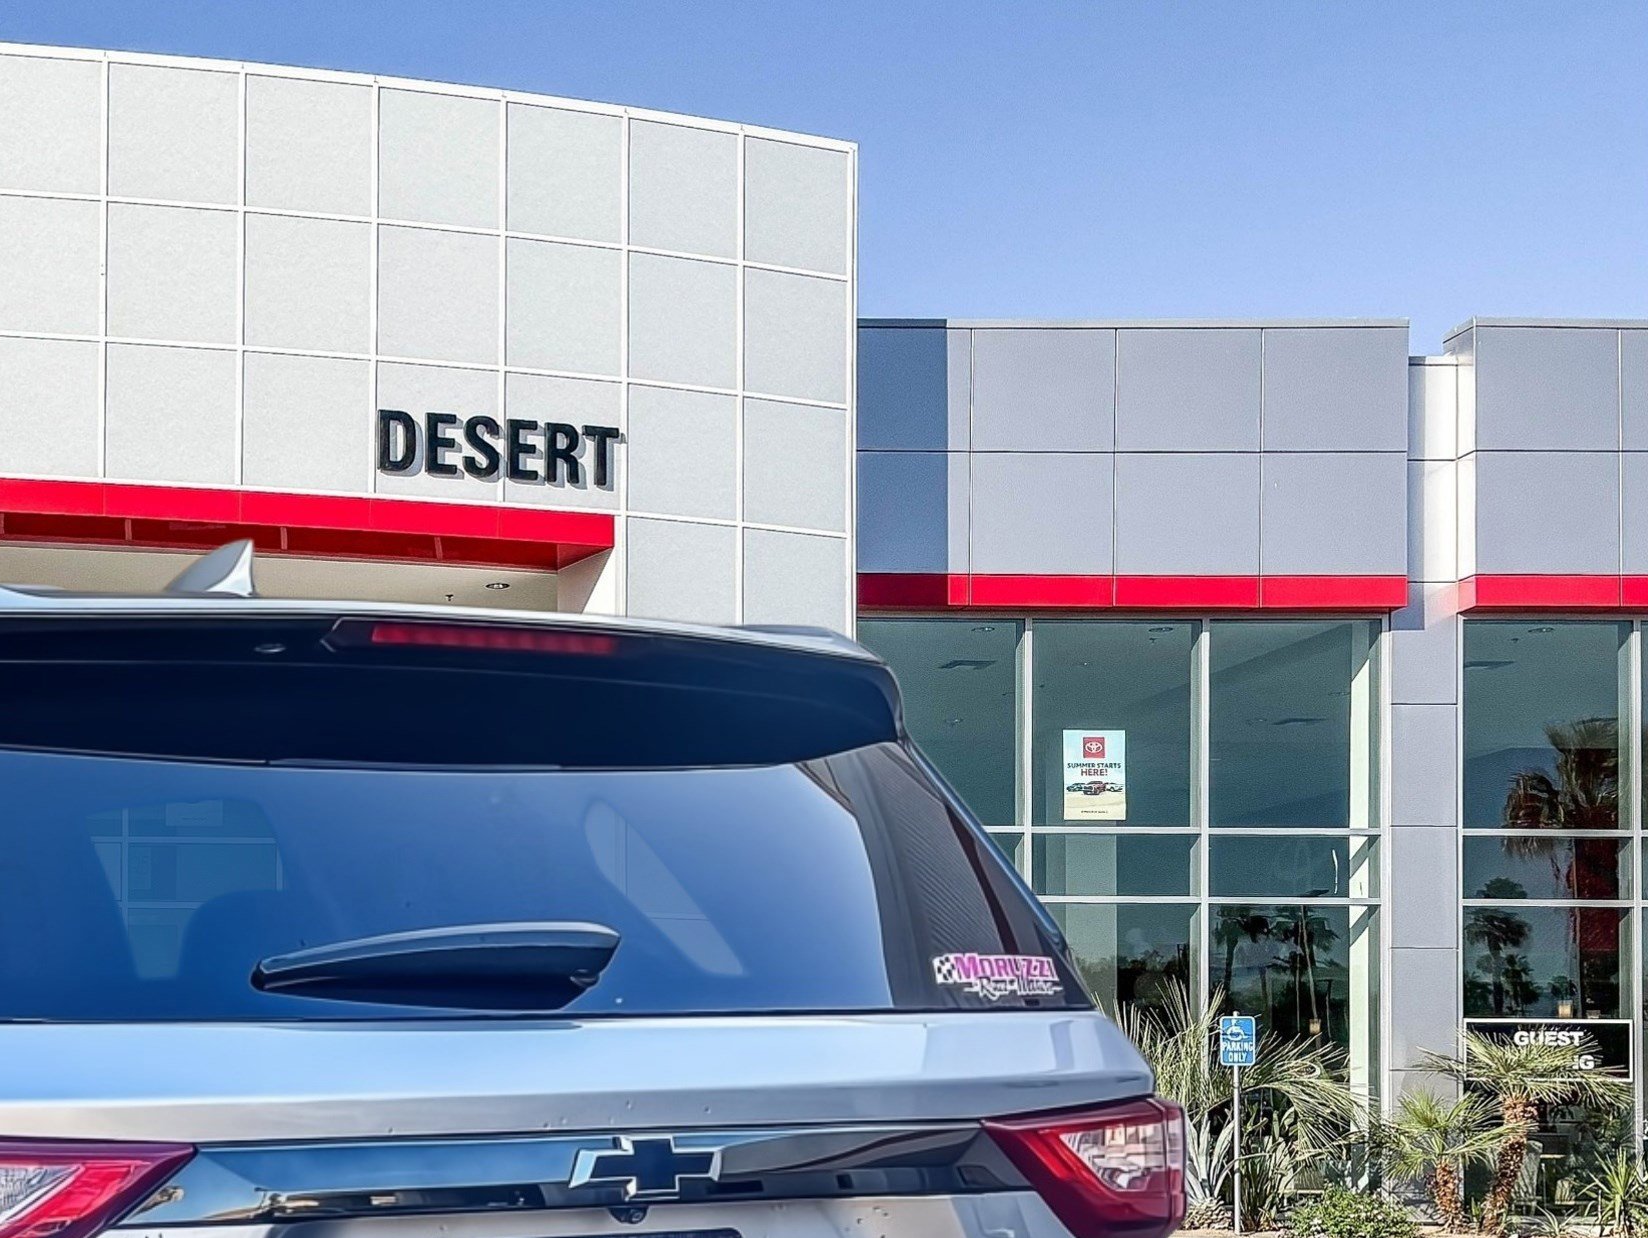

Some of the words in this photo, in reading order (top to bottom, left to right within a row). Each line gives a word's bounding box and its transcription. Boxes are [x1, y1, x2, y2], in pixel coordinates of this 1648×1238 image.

[377, 408, 621, 487] DESERT
[1080, 768, 1108, 777] HERE!
[1513, 1030, 1584, 1047] GUEST
[1221, 1041, 1253, 1052] PARKING
[1228, 1051, 1248, 1063] ONLY
